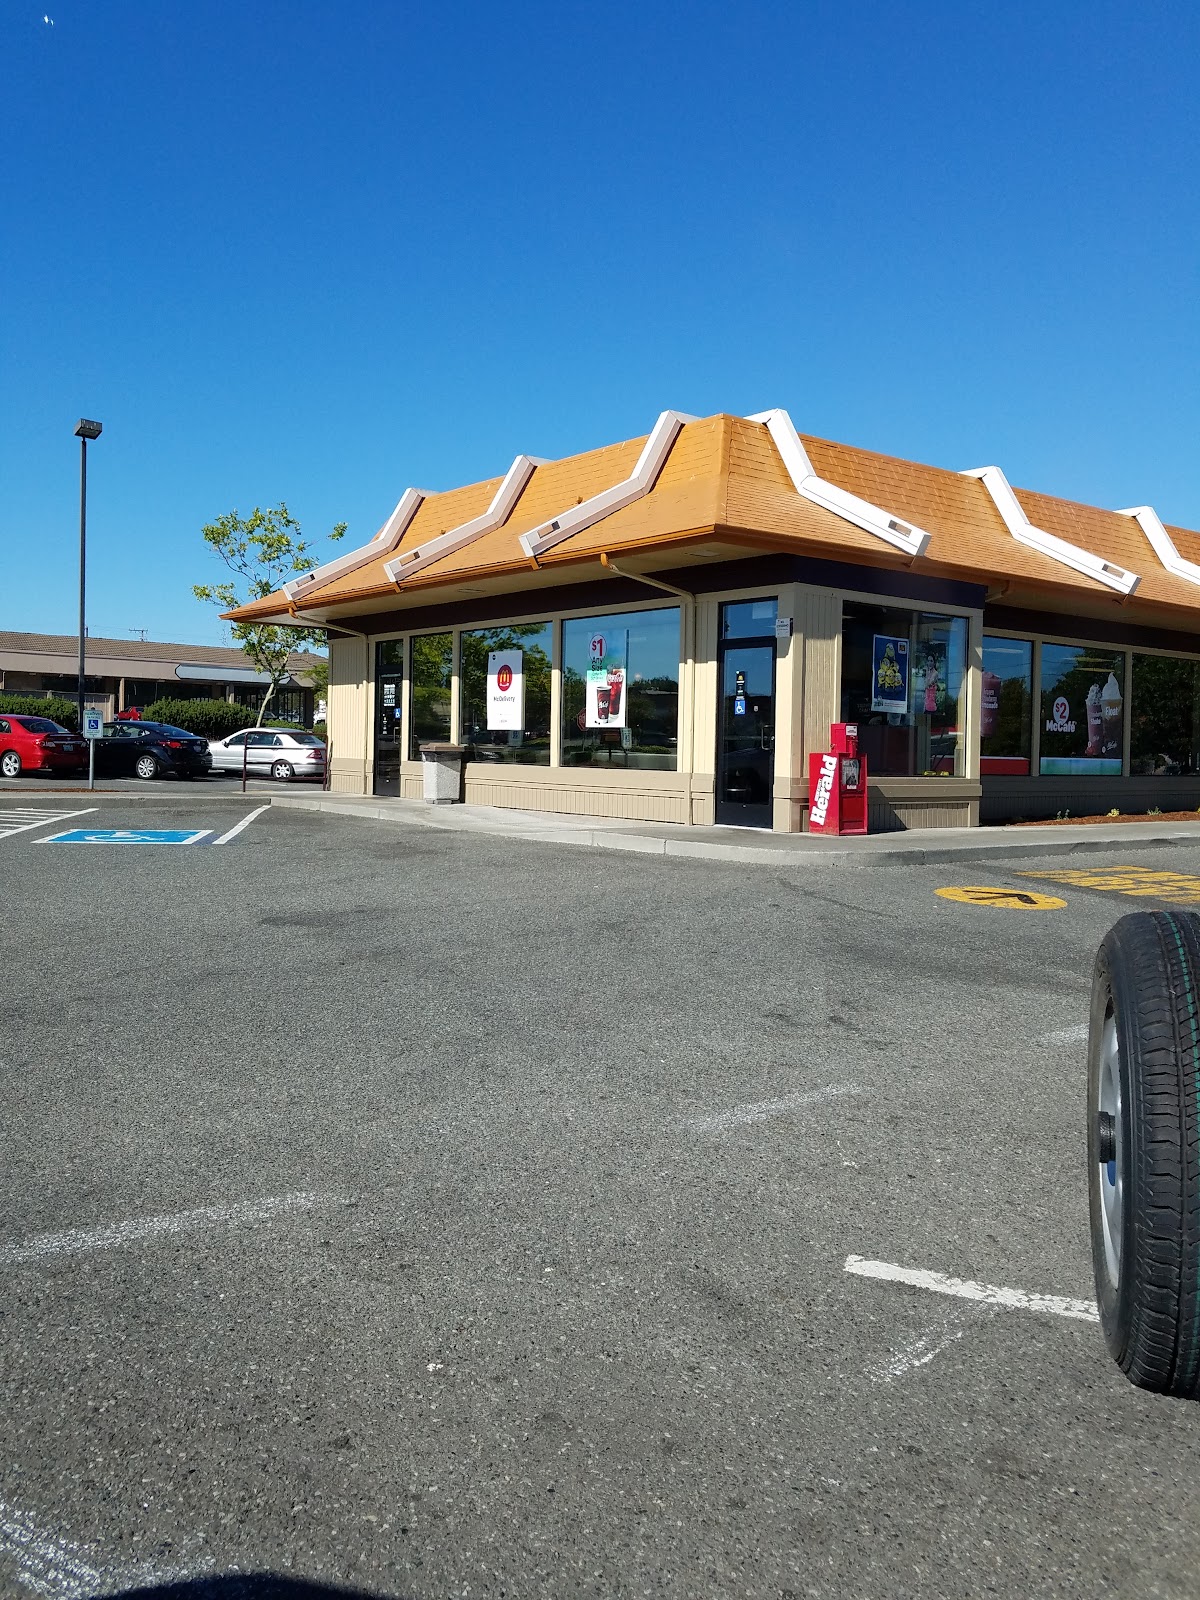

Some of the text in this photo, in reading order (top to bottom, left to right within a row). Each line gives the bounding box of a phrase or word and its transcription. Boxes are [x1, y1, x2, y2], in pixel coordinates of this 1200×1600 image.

[591, 638, 603, 657] $1
[591, 657, 603, 665] Any
[591, 664, 603, 672] Size
[493, 695, 516, 703] McDelivery
[1055, 702, 1067, 720] $2
[810, 755, 837, 825] Herald
